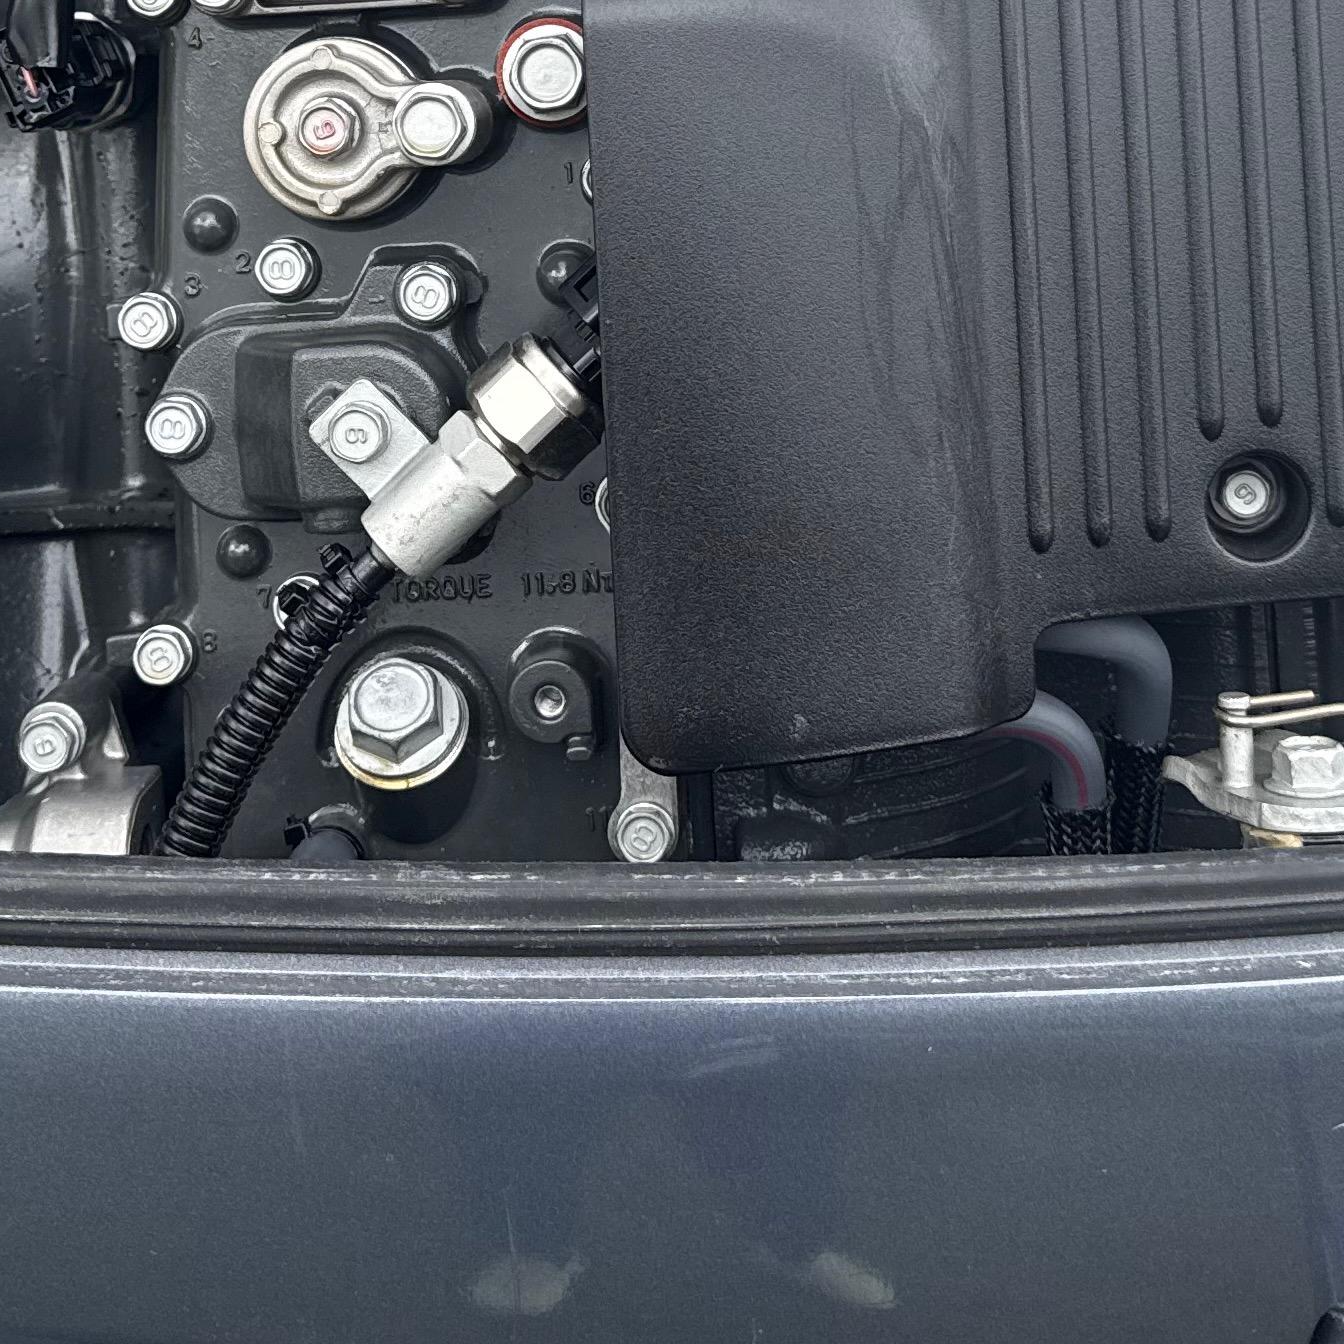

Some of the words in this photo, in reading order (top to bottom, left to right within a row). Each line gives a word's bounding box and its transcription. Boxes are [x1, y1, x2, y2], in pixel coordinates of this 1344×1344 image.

[235, 250, 252, 274] 2
[183, 271, 202, 297] 3
[579, 480, 595, 505] 6
[390, 572, 493, 604] TORQUE
